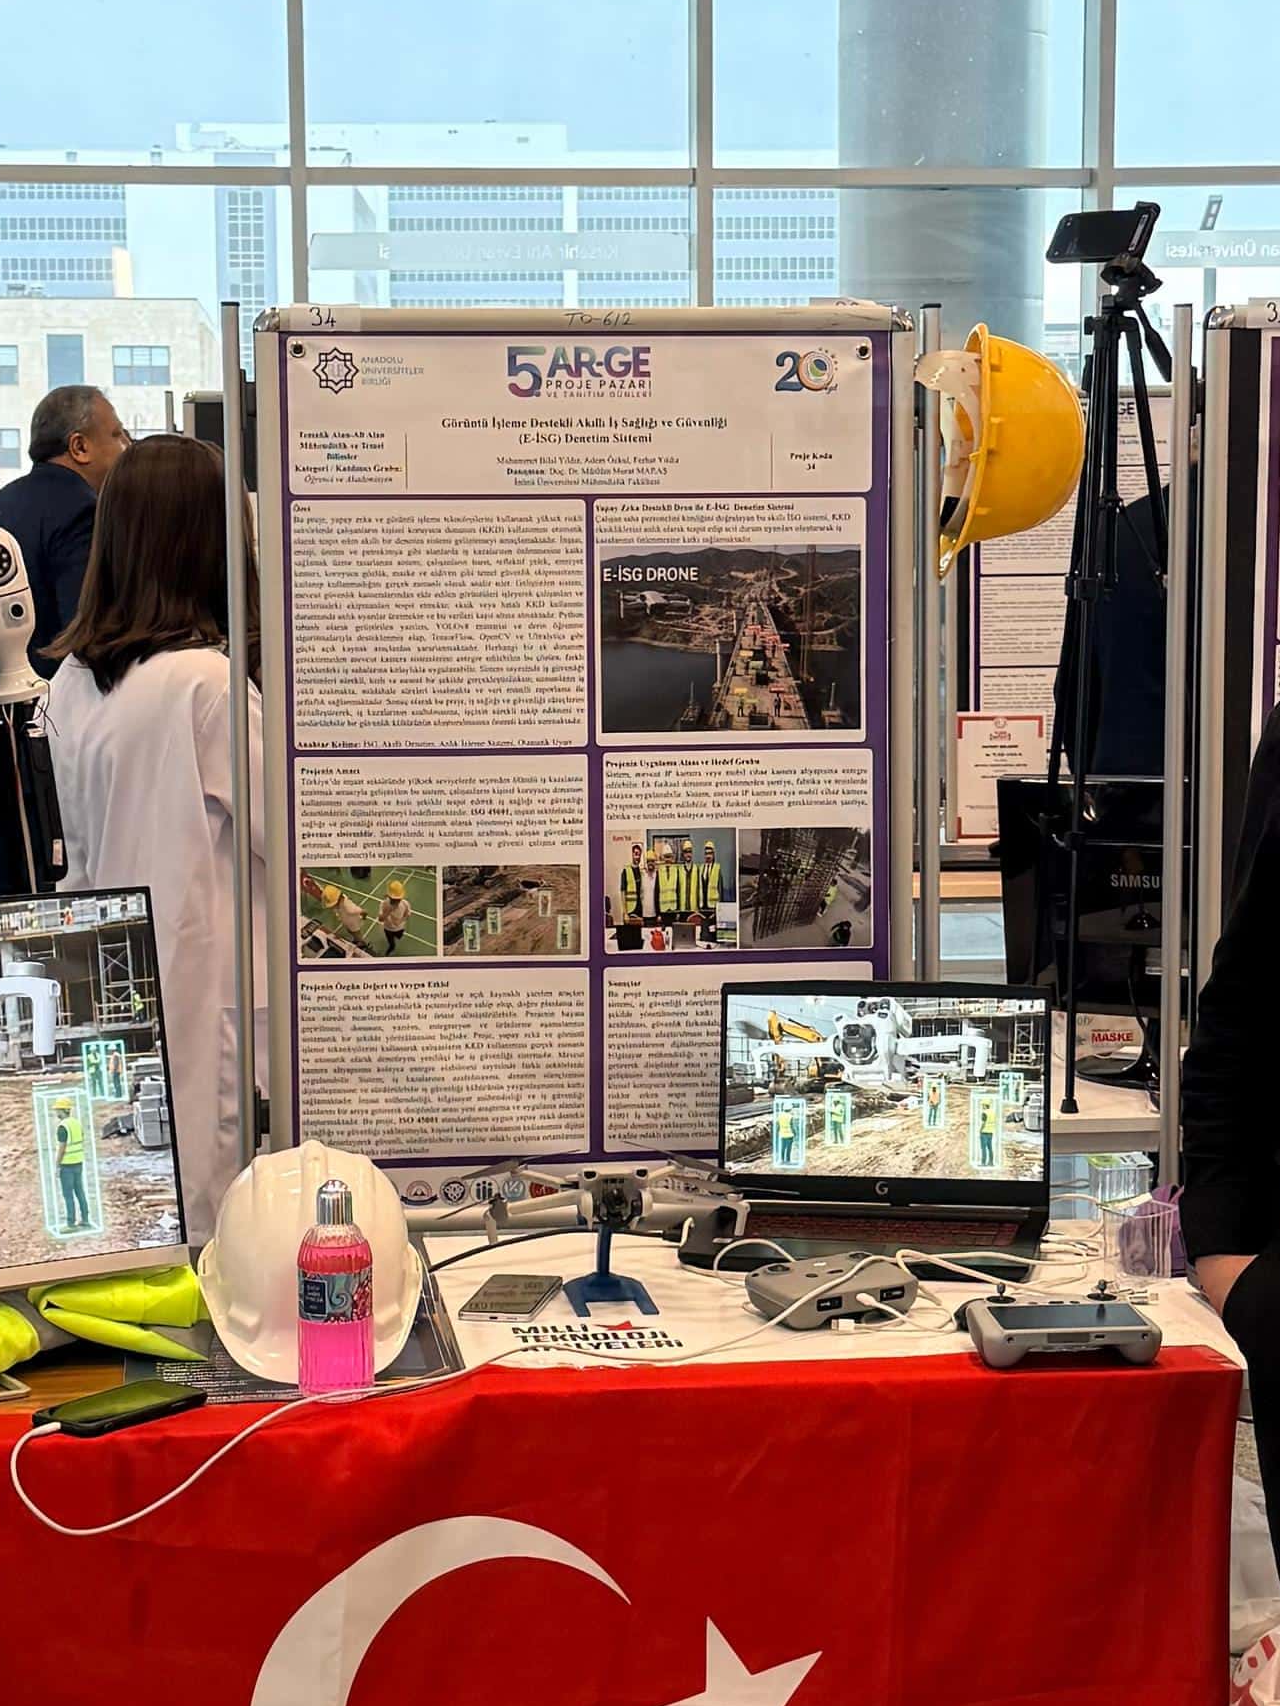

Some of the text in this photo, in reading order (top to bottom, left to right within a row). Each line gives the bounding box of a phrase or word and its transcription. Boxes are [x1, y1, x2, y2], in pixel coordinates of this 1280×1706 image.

[310, 307, 336, 327] 34
[547, 346, 651, 378] AR-GE
[546, 380, 652, 389] PROJE PAZARI
[442, 417, 488, 430] Görüntü
[492, 417, 527, 430] İşleme
[530, 417, 573, 430] Destekli
[609, 417, 618, 430] İş
[662, 417, 672, 430] ve
[676, 417, 727, 430] Güvenliği
[519, 431, 562, 445] (E-İSG)
[565, 431, 610, 445] Denetim
[603, 565, 698, 582] E-İSG DRONE
[1111, 874, 1161, 888] SAMSU
[1091, 1032, 1134, 1042] MASKE
[514, 1331, 669, 1343] TEKNOLOJİ
